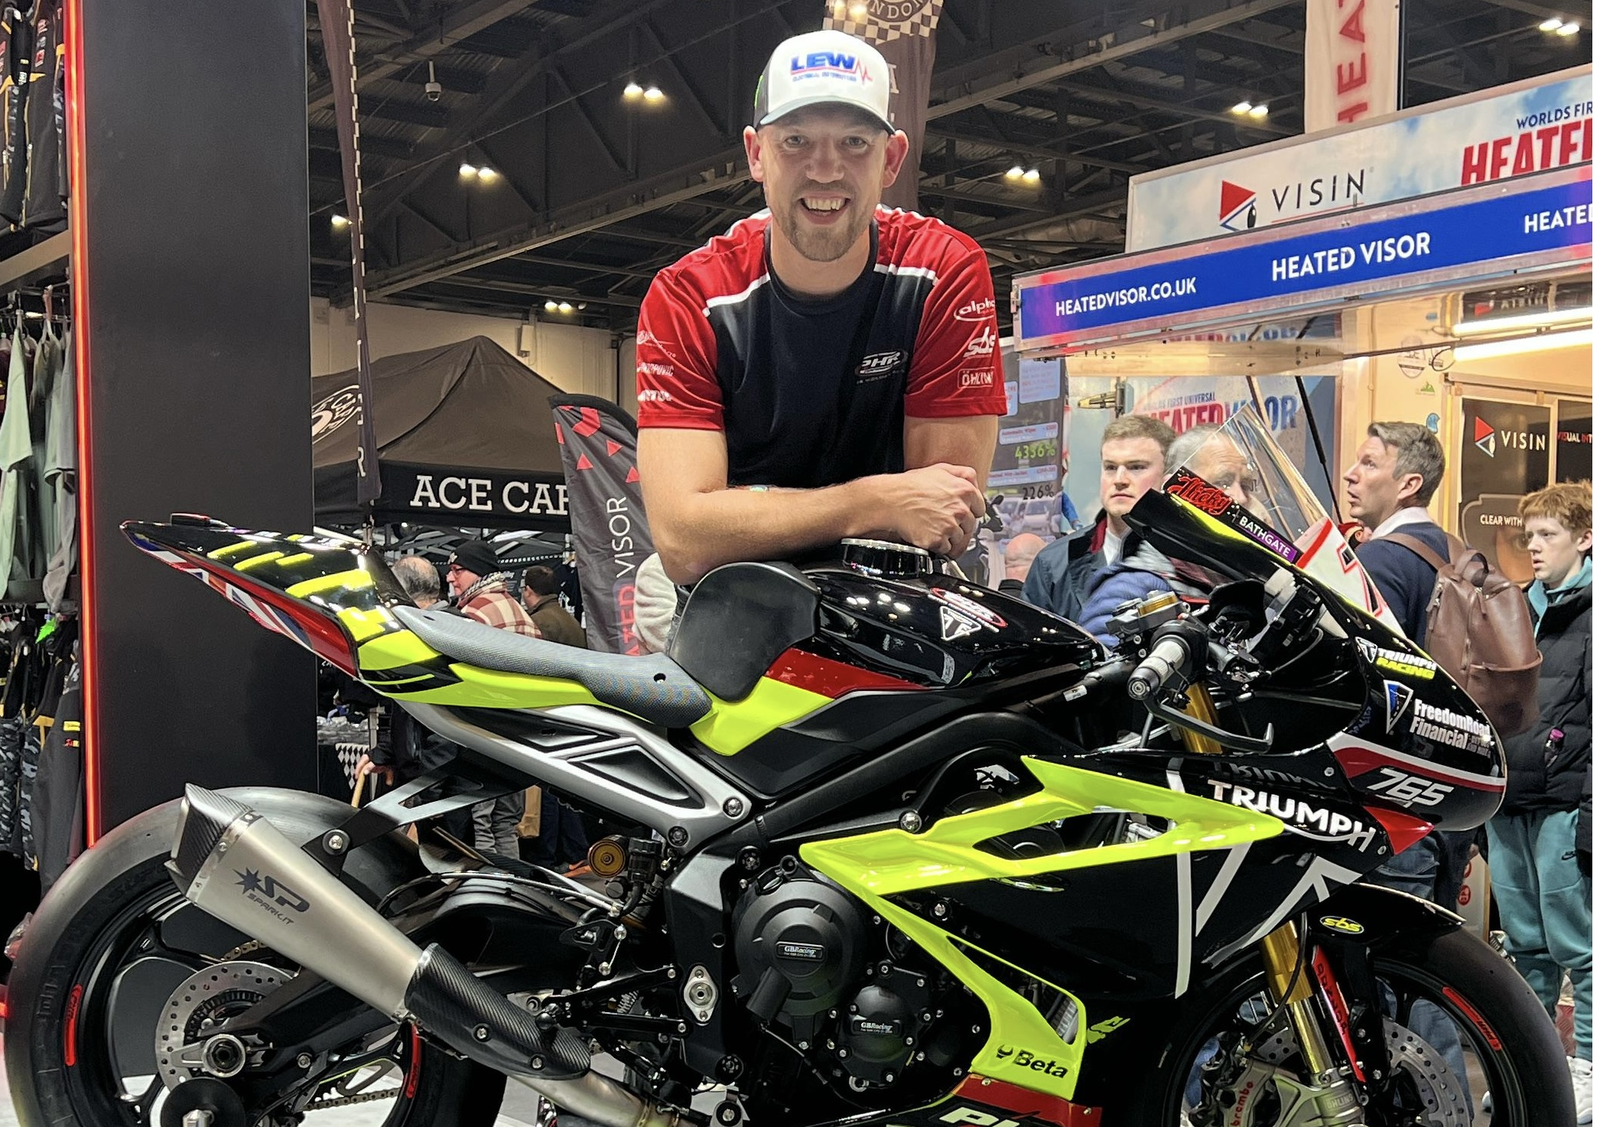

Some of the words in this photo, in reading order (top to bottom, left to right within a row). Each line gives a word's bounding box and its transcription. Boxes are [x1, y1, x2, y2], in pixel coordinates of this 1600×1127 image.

[791, 52, 856, 71] LEW
[1516, 106, 1571, 129] WORLDS
[1271, 168, 1366, 213] VISIN
[1272, 246, 1356, 282] HEATED
[1360, 231, 1431, 265] VISOR
[1055, 276, 1197, 317] HEATEDVISOR.CO.UK
[1184, 392, 1217, 406] UNIVERSAL
[1501, 430, 1546, 451] VISIN
[410, 475, 493, 511] ACE
[1023, 484, 1055, 500] 226%
[606, 497, 636, 578] VISOR
[1239, 515, 1292, 558] BATHGATE
[1480, 514, 1503, 526] CLEAR
[1504, 516, 1523, 527] WITH
[1375, 657, 1436, 680] RACING
[1377, 647, 1438, 671] TRIUMPH
[1409, 716, 1469, 750] Financial
[1414, 698, 1491, 737] FreedomRoad
[1366, 767, 1454, 806] 765
[1207, 779, 1377, 853] TRIUMPH
[1013, 1049, 1069, 1079] Beta
[1230, 1081, 1255, 1127] brembo
